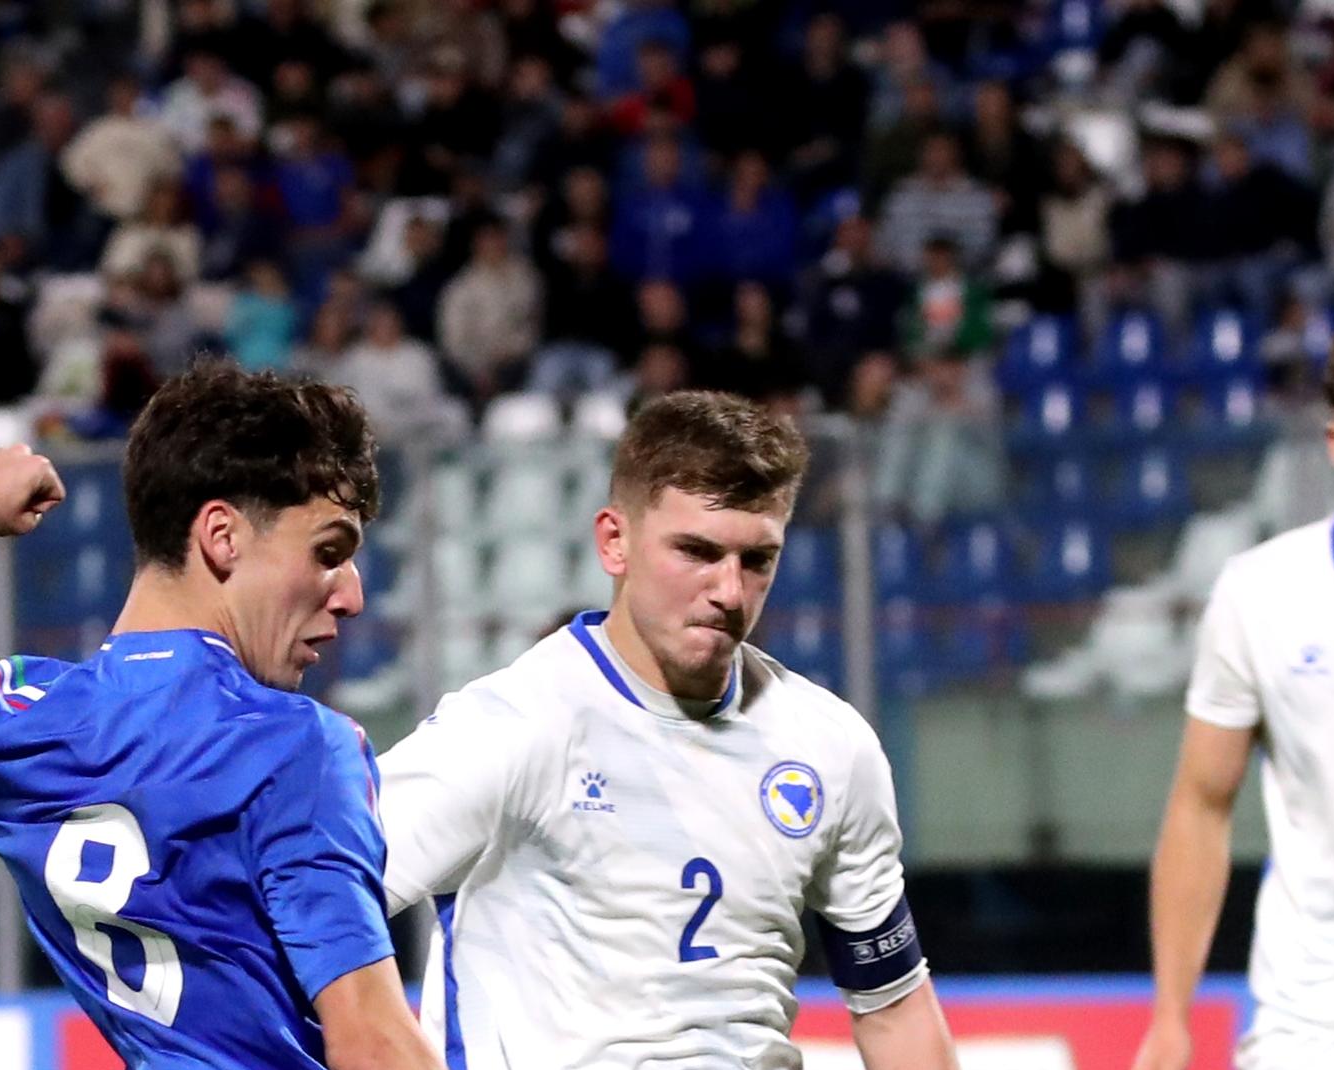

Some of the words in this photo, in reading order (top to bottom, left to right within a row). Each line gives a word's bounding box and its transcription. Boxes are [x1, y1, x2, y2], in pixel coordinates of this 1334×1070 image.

[572, 801, 616, 813] KELME
[45, 803, 184, 1027] 8
[679, 857, 723, 962] 2
